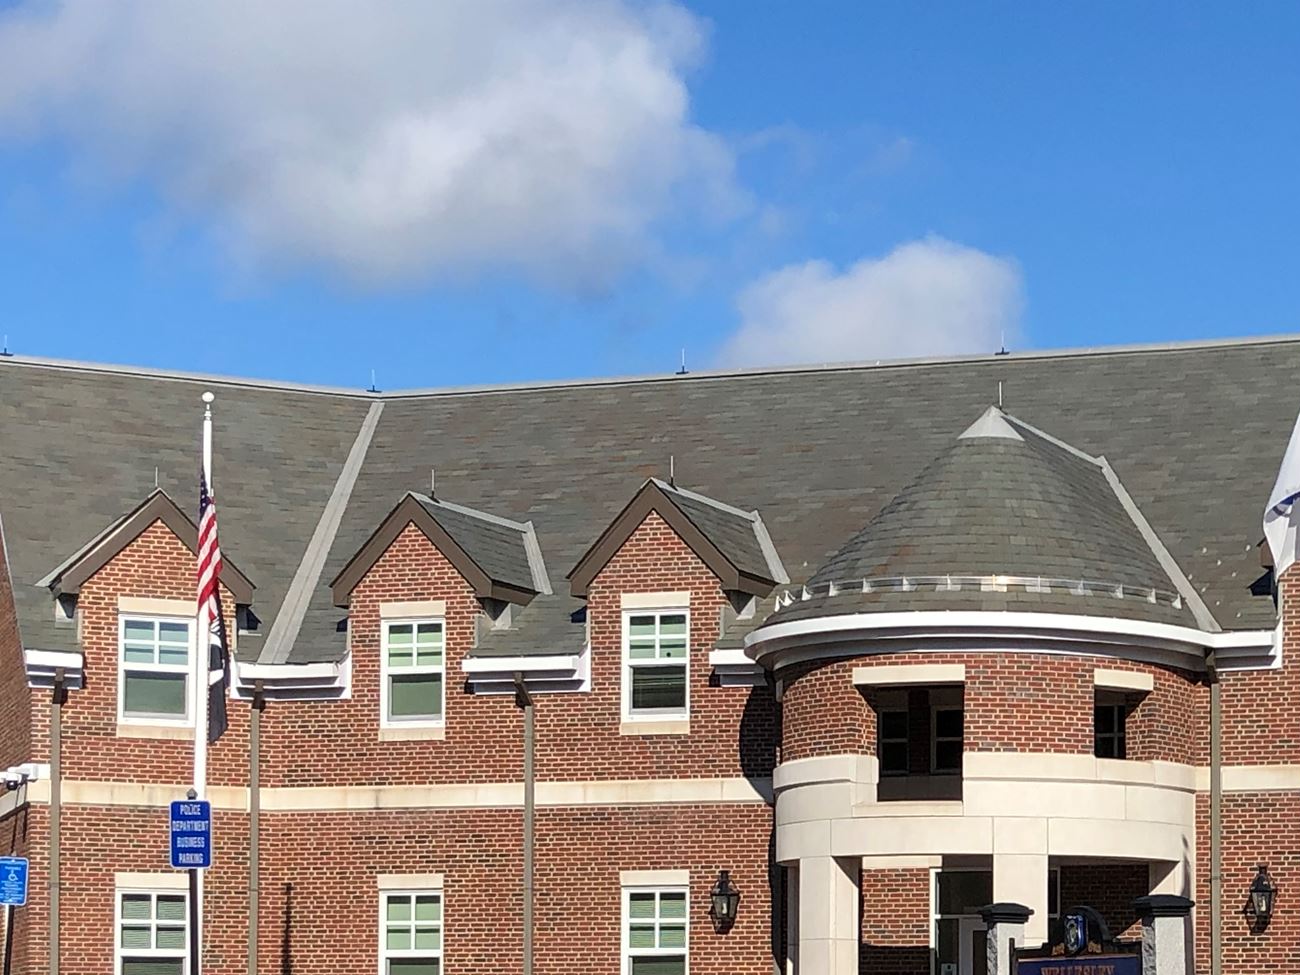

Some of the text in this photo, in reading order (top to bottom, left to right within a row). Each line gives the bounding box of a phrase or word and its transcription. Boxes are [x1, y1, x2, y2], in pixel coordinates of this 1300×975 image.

[180, 804, 201, 815] POLICE
[172, 820, 209, 831] DEPARTMENT
[176, 836, 205, 848] BUSINESS
[178, 853, 203, 864] PARKING
